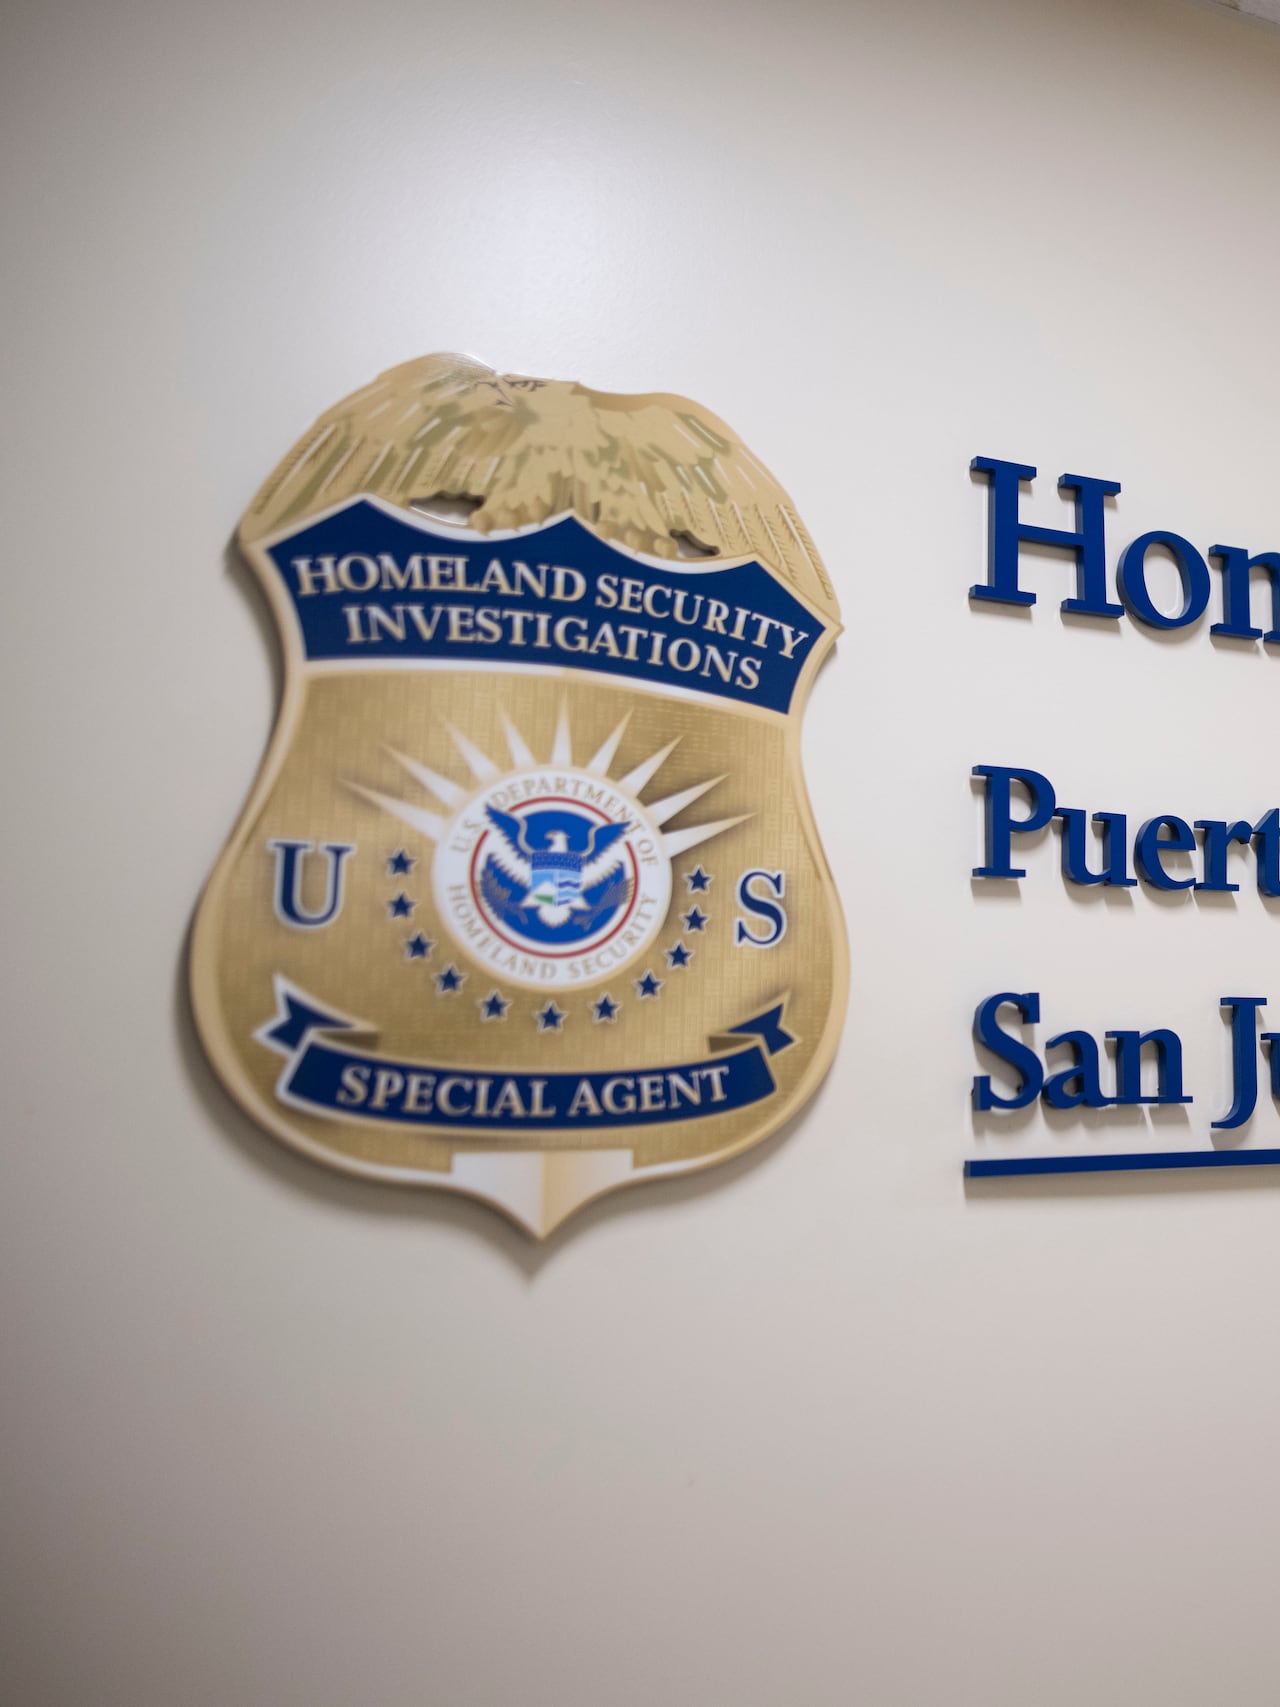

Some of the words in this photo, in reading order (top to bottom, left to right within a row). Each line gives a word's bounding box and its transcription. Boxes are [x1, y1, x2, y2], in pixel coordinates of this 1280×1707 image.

[291, 552, 587, 602] HOMELAND
[595, 572, 809, 660] SECURITY
[342, 602, 762, 690] INVESTIGATIONS
[493, 775, 645, 835] DEPARTMENT
[637, 838, 658, 866] OF
[448, 883, 557, 980] HOMELAND
[566, 892, 658, 980] SECURITY
[336, 1064, 556, 1119] SPECIAL
[567, 1065, 729, 1117] AGENT
[973, 993, 1194, 1112] San
